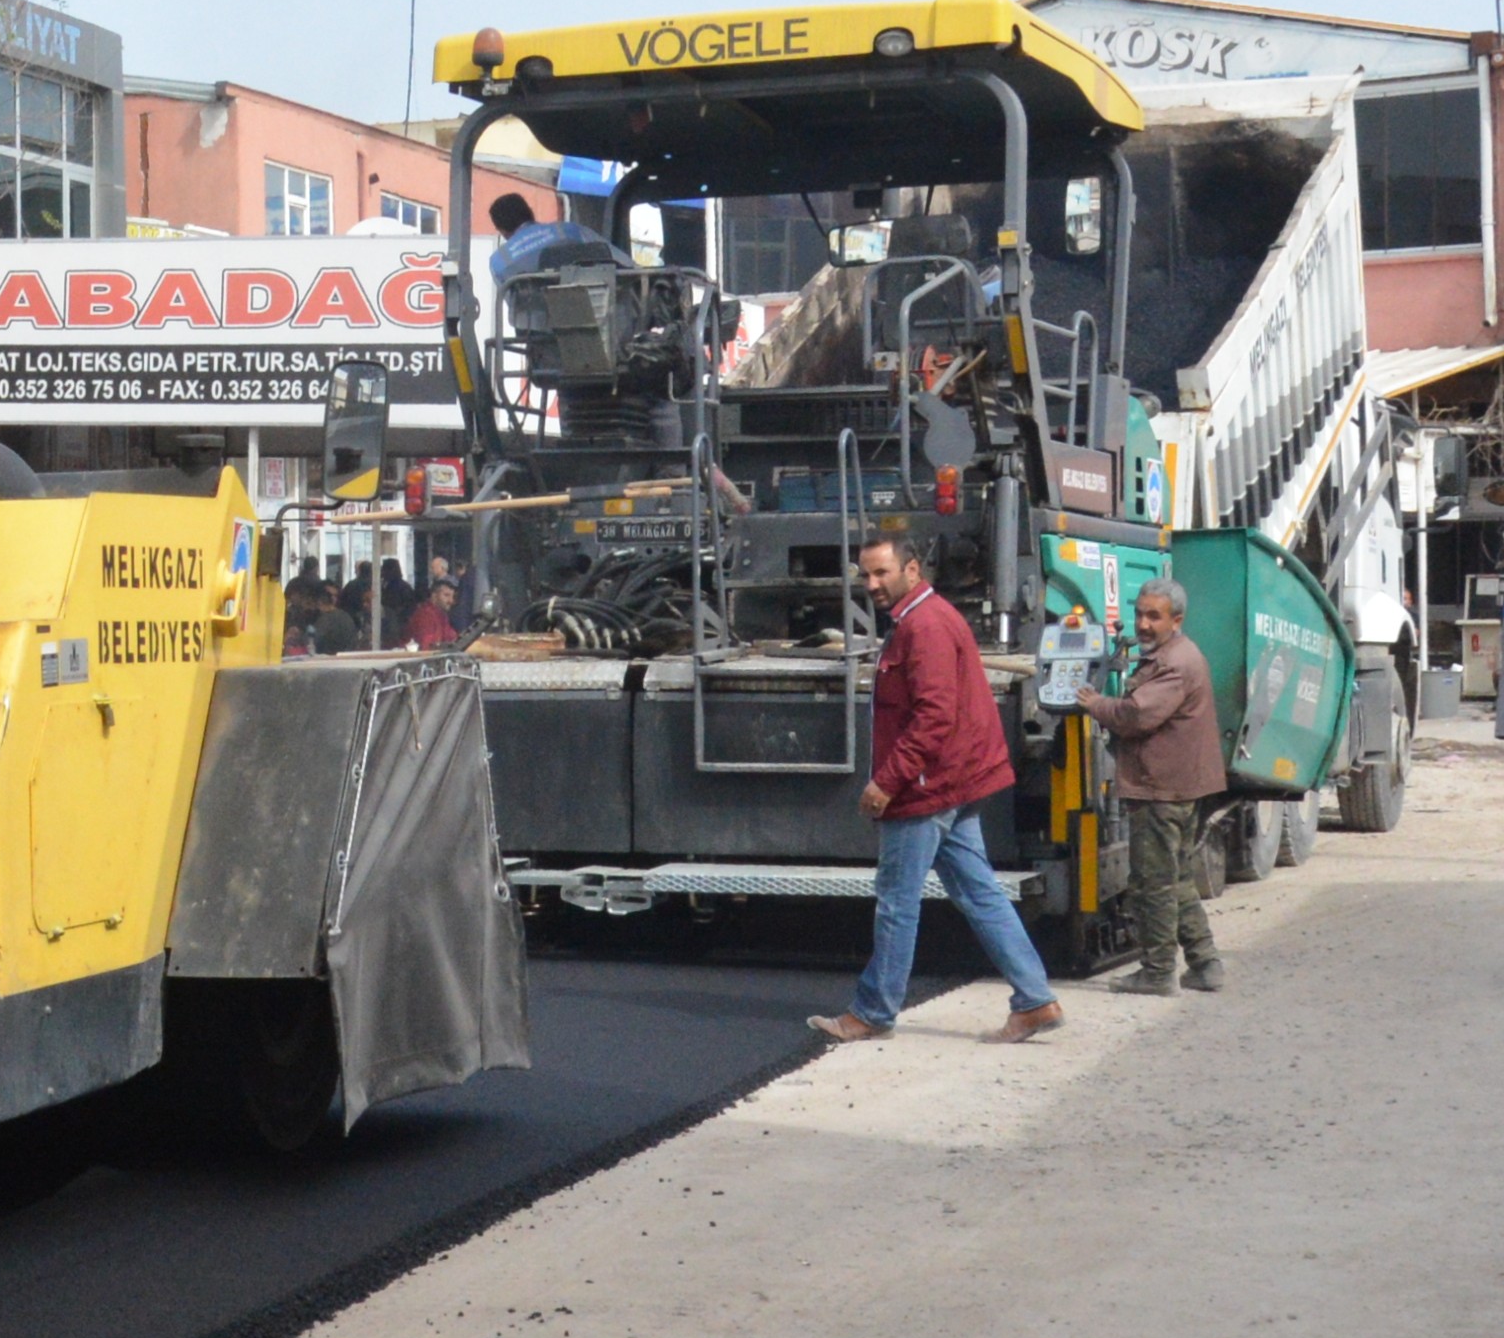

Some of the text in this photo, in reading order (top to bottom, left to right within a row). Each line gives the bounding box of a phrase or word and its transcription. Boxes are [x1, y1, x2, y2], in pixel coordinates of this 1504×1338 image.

[617, 18, 809, 67] VÖGELE
[53, 378, 86, 400] 326
[92, 378, 115, 400] 75
[119, 378, 142, 400] 06
[160, 379, 205, 400] FAX:
[211, 379, 263, 400] 0.352
[268, 379, 302, 399] 326
